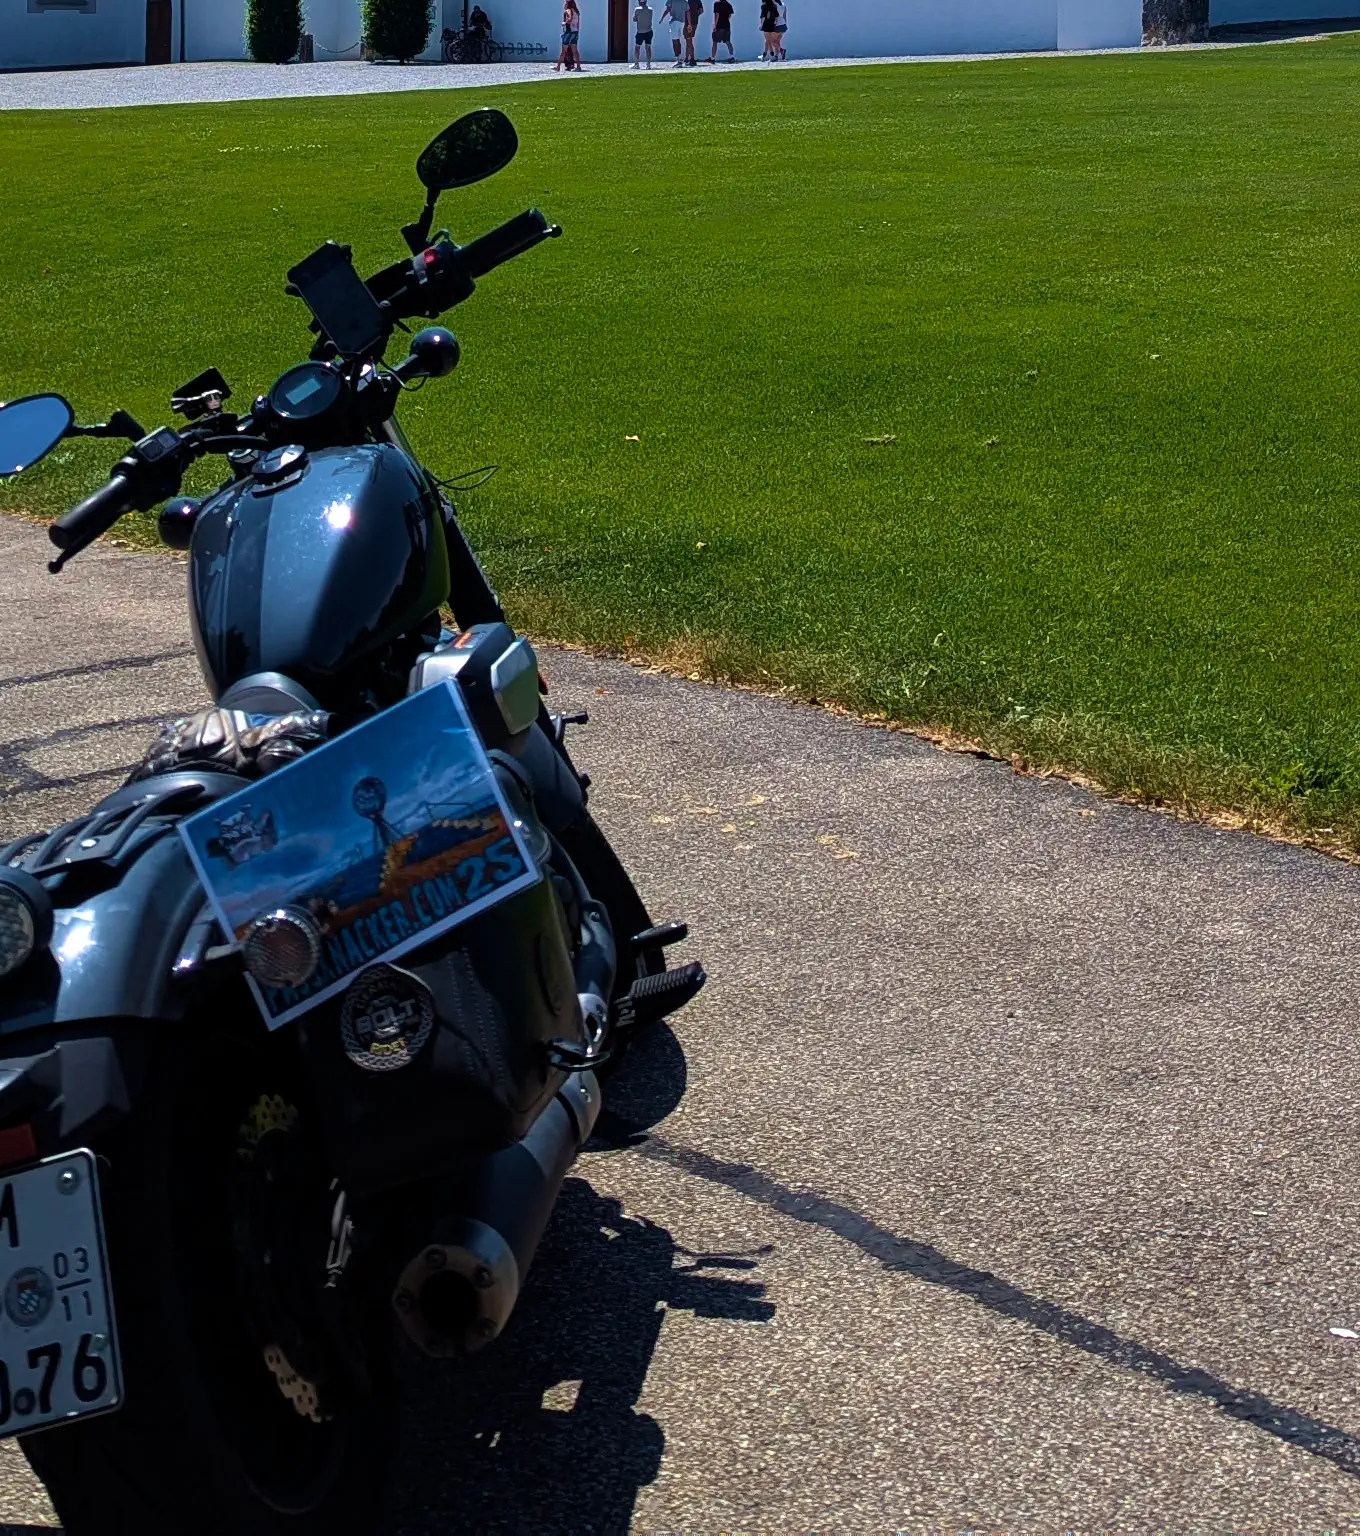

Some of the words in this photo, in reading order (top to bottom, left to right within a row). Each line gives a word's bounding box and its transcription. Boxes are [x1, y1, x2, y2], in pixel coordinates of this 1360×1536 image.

[457, 836, 524, 900] 25
[355, 999, 416, 1035] BOLT
[53, 1247, 89, 1280] 03
[60, 1291, 93, 1321] 11
